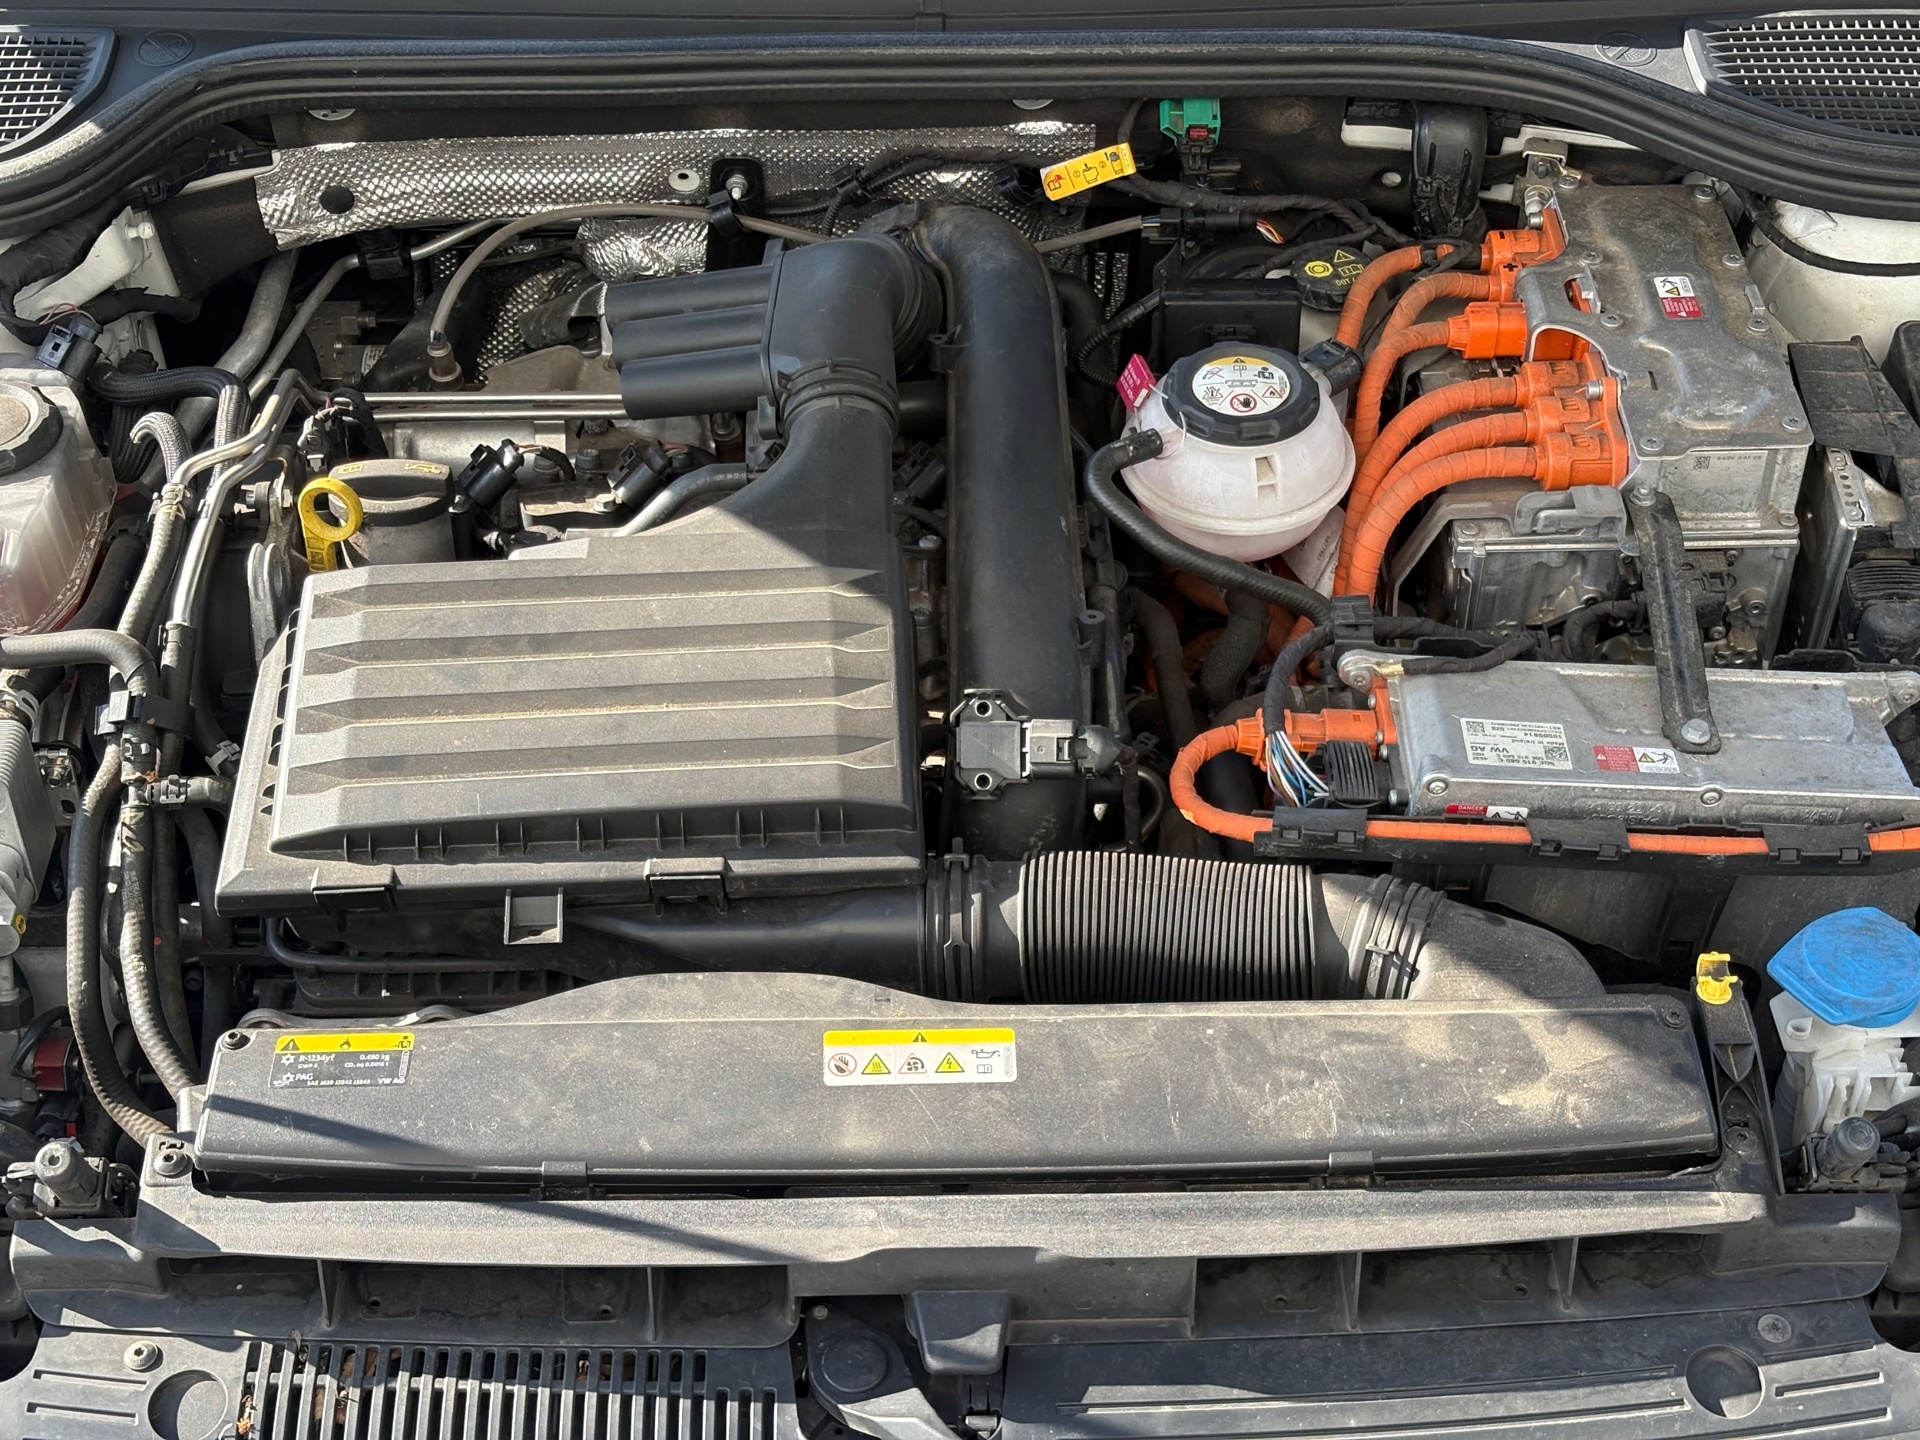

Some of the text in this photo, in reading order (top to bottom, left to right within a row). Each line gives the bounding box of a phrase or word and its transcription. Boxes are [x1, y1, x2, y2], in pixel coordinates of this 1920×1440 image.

[1335, 278, 1351, 287] DOT
[1490, 746, 1509, 754] VW
[298, 1054, 336, 1063] R-1234yf
[295, 1073, 314, 1081] PAG
[377, 1077, 392, 1085] VW
